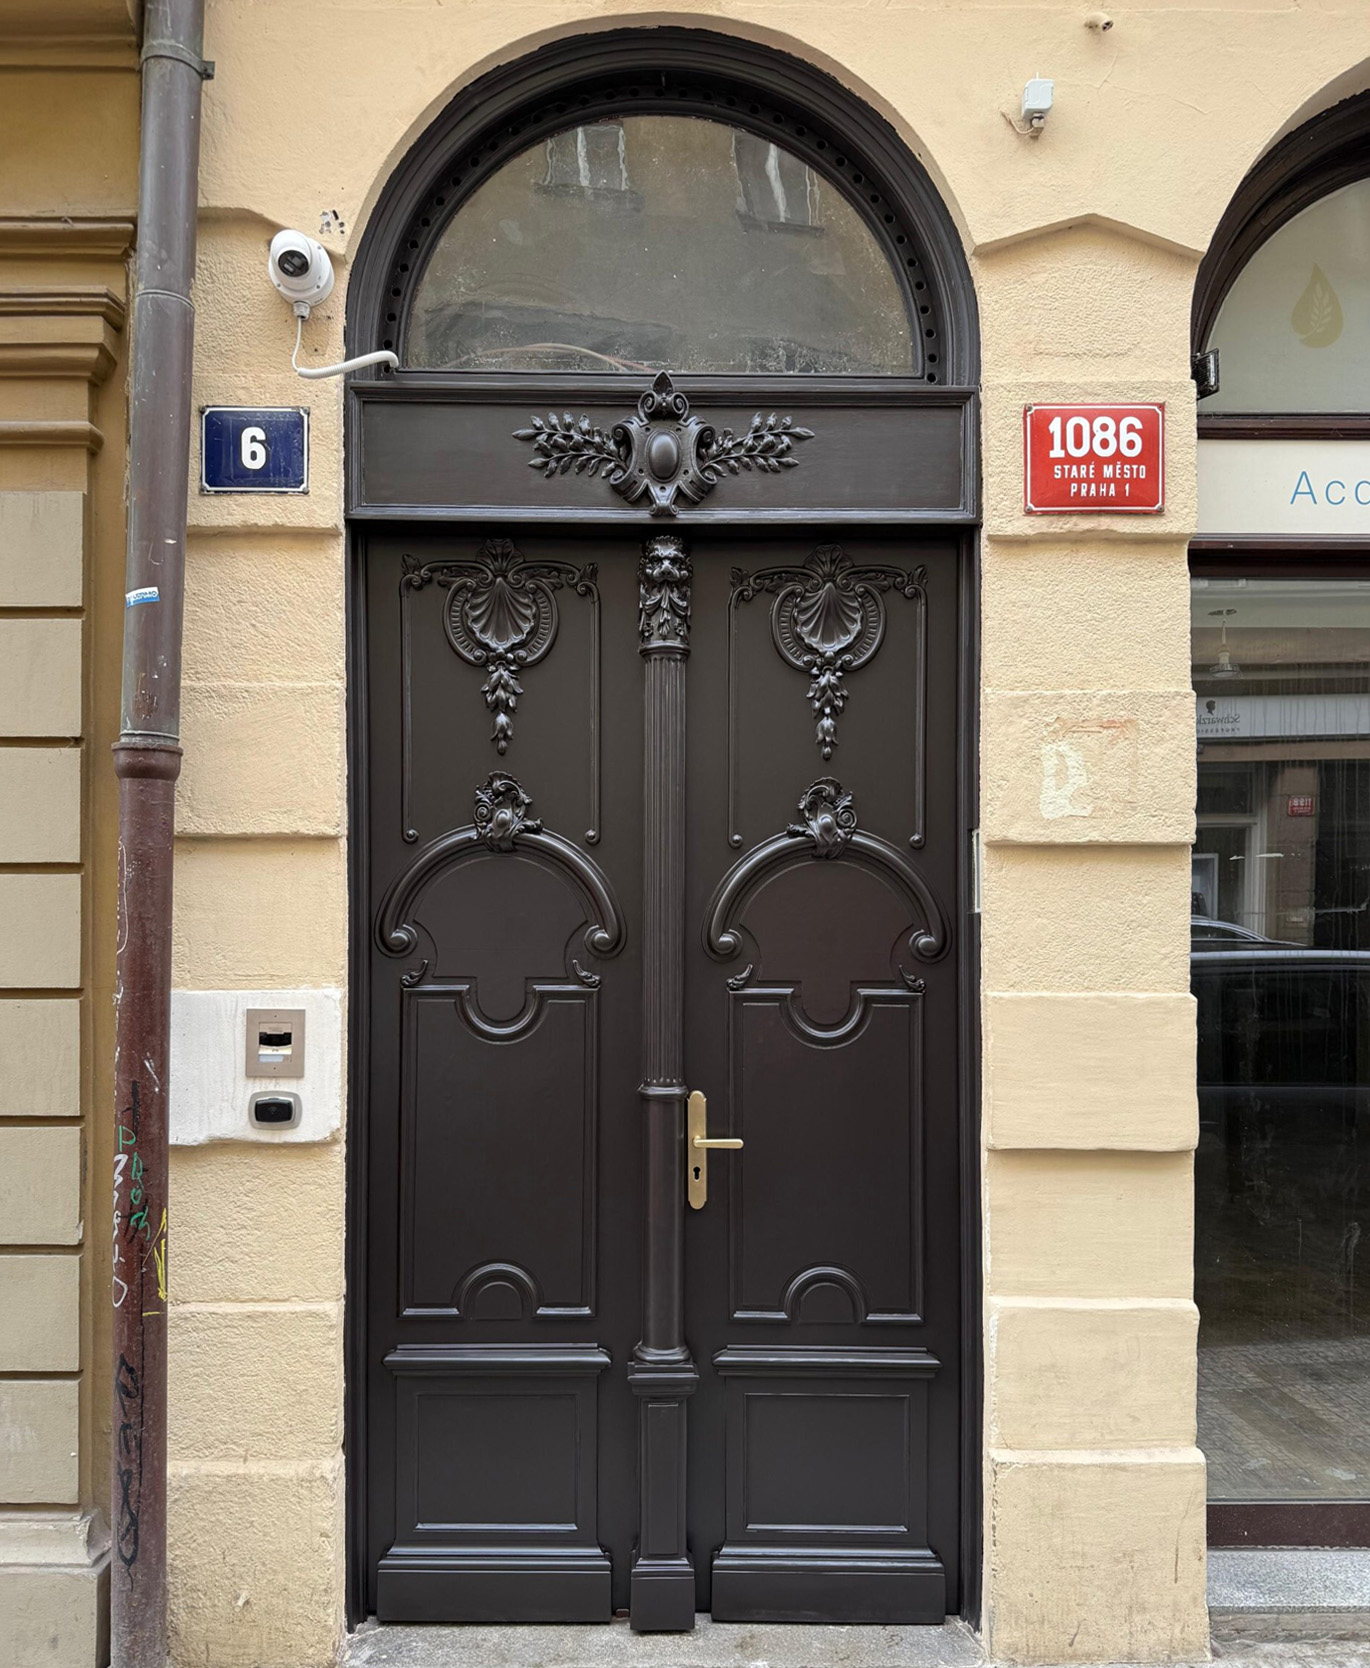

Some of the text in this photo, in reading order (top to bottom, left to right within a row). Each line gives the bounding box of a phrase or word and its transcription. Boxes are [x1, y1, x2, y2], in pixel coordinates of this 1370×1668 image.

[241, 426, 267, 470] 6
[1048, 416, 1143, 458] 1086
[1054, 461, 1146, 479] STARÉ MĚSTO
[1070, 483, 1130, 497] PRAHA 1
